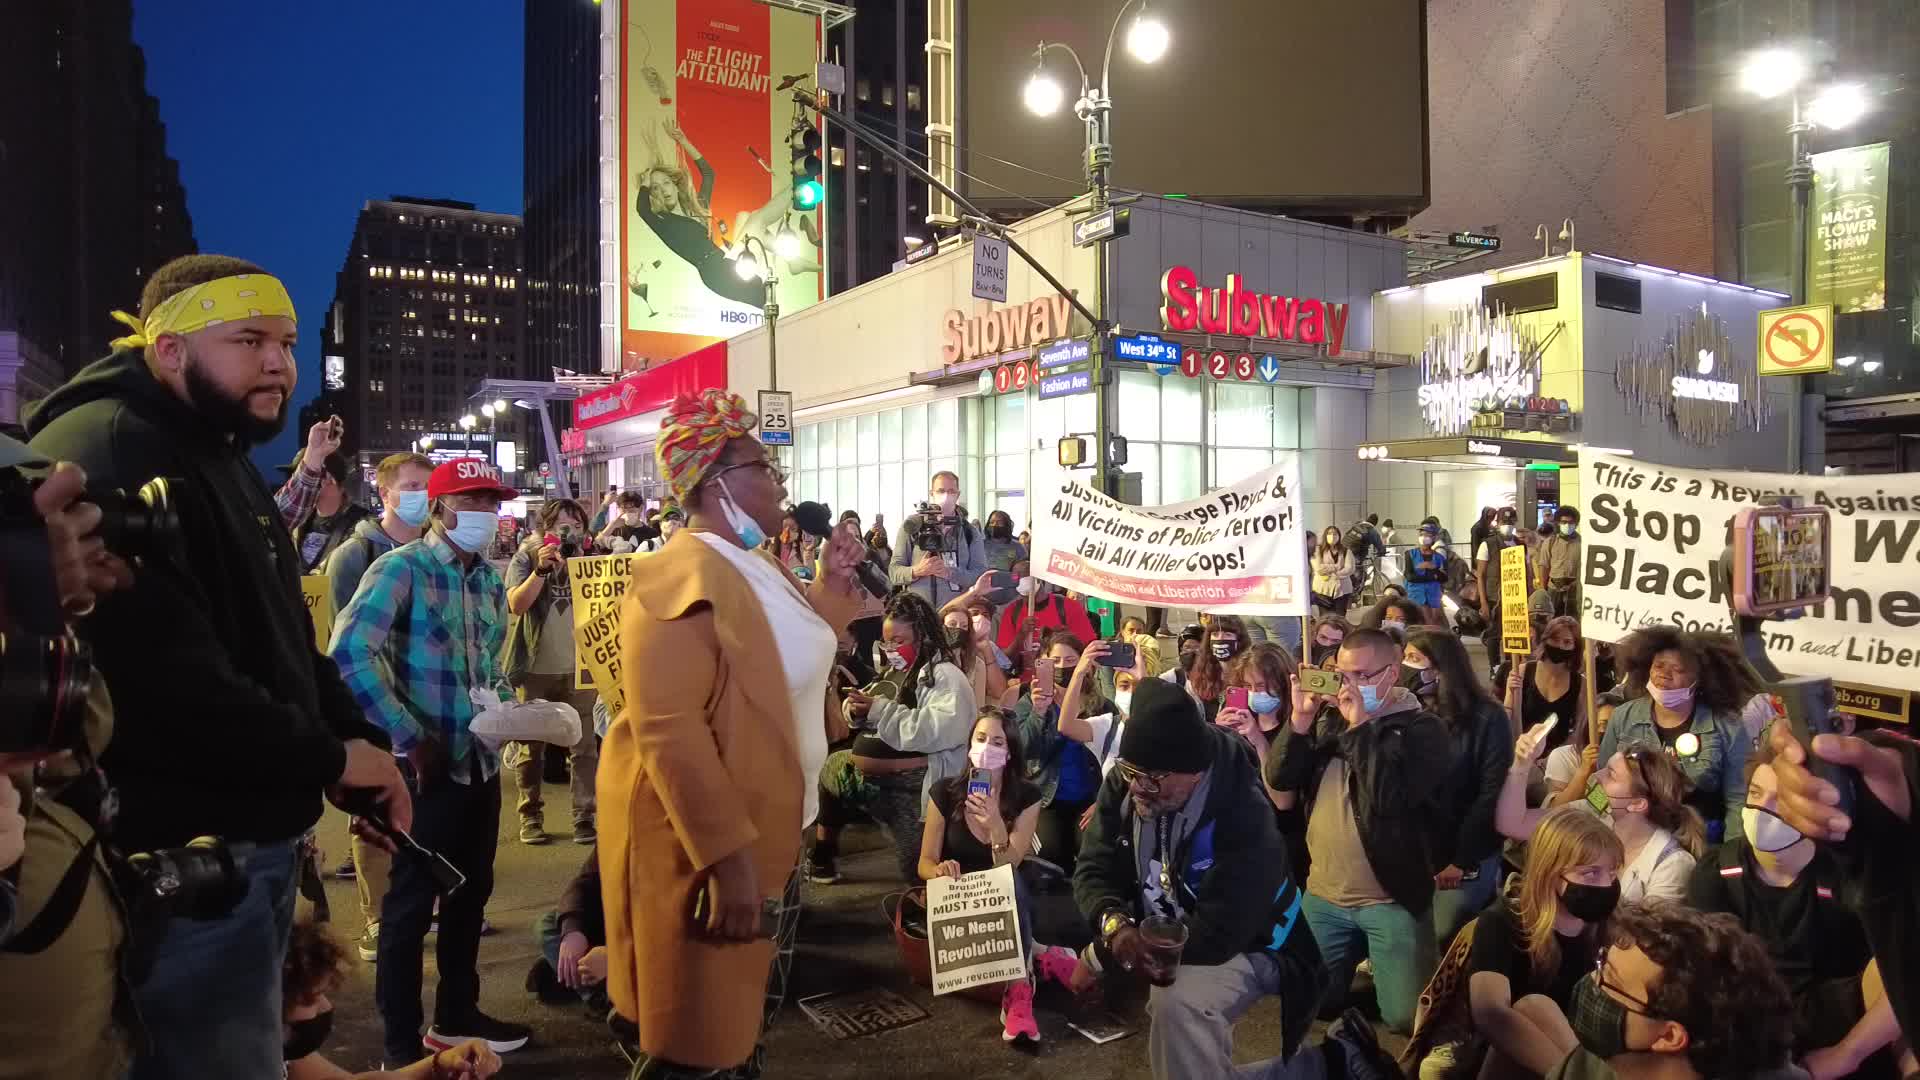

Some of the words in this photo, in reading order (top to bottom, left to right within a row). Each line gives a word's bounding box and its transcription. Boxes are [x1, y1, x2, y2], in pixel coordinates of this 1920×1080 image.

[686, 48, 704, 62] THE
[706, 46, 763, 73] FLIGHT
[676, 59, 771, 94] ATTENDANT
[1821, 205, 1874, 225] MACY'S
[1817, 218, 1877, 240] FLOWER
[1456, 235, 1498, 246] SILVERCAST
[1824, 233, 1870, 252] SHOW
[982, 244, 999, 260] NO
[976, 263, 1005, 281] TURNS
[1160, 266, 1348, 356] Subway
[943, 289, 1072, 364] Subway
[1041, 347, 1070, 365] Seventh
[1072, 345, 1088, 359] Ave
[1120, 341, 1145, 357] West
[1147, 344, 1165, 358] 34th
[1166, 346, 1177, 359] St
[1042, 379, 1071, 394] Fashion
[1072, 376, 1088, 389] Ave
[765, 414, 787, 428] 25
[1593, 461, 1646, 490] This
[1650, 470, 1679, 493] is
[1684, 479, 1703, 497] a
[1218, 481, 1268, 515] Floyd
[1271, 475, 1287, 499] &
[1052, 499, 1073, 521] All
[1079, 507, 1144, 541] Victims
[1147, 526, 1171, 545] of
[1169, 526, 1220, 547] Police
[1588, 493, 1701, 555] Stop
[1077, 537, 1107, 561] Jail
[1107, 546, 1137, 569] All
[1136, 551, 1185, 573] Killer
[1186, 545, 1247, 576] Cops!
[576, 558, 632, 580] JUSTICE
[1051, 554, 1080, 576] Party
[1156, 584, 1225, 599] Liberation
[1583, 544, 1734, 604] Black
[581, 581, 629, 600] GEOR
[1581, 597, 1634, 631] Party
[1800, 639, 1844, 658] and
[942, 892, 963, 902] and
[964, 887, 1001, 899] Murder
[949, 880, 992, 892] Brutality
[933, 901, 969, 916] MUST
[973, 895, 1010, 909] STOP!
[942, 924, 965, 941] We
[968, 918, 1005, 935] Need
[938, 938, 1015, 965] Revolution
[937, 966, 1022, 991] www.revcom.us
